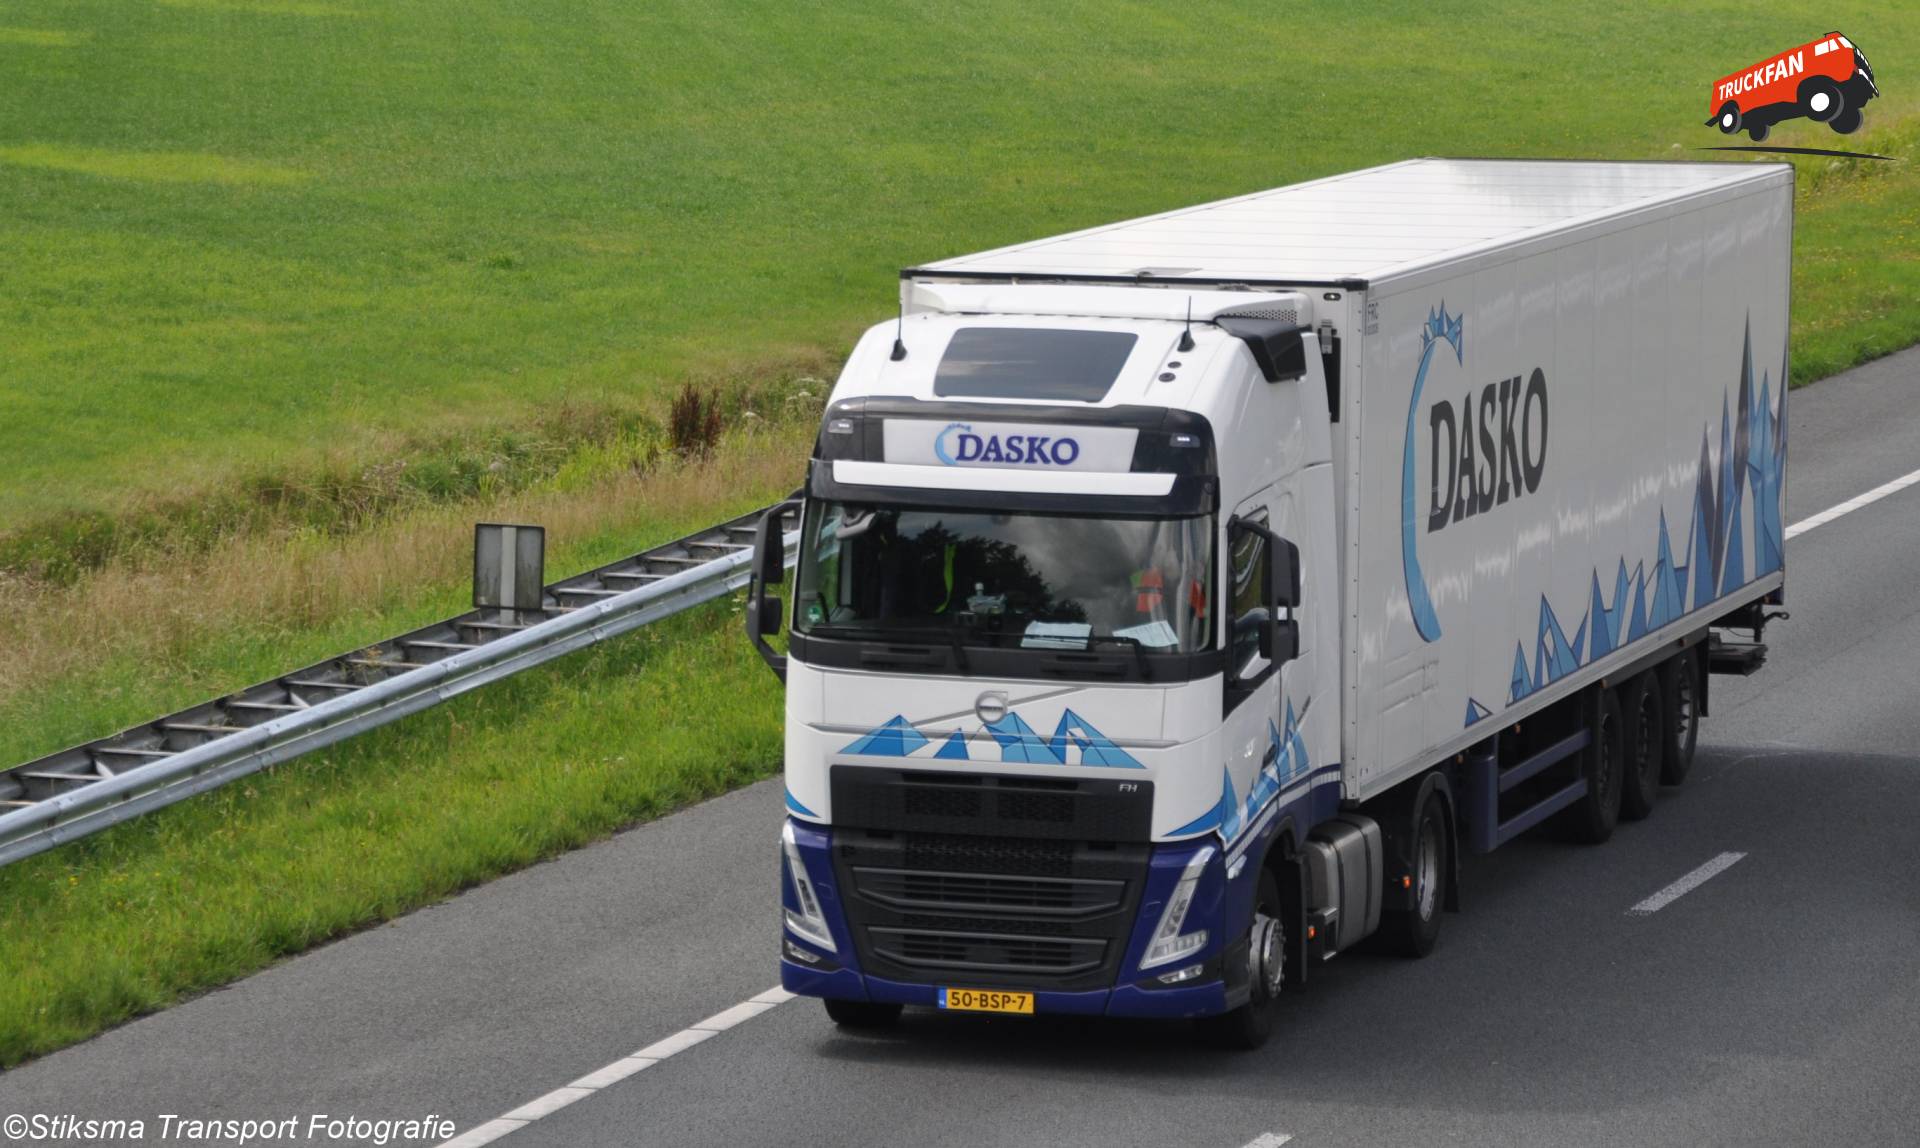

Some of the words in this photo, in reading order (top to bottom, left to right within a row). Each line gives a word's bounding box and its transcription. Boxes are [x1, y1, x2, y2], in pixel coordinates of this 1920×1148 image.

[955, 433, 1080, 466] DASKO
[1428, 366, 1549, 534] DASKO
[1119, 783, 1138, 793] FH
[951, 991, 1026, 1010] 50-BSP-7
